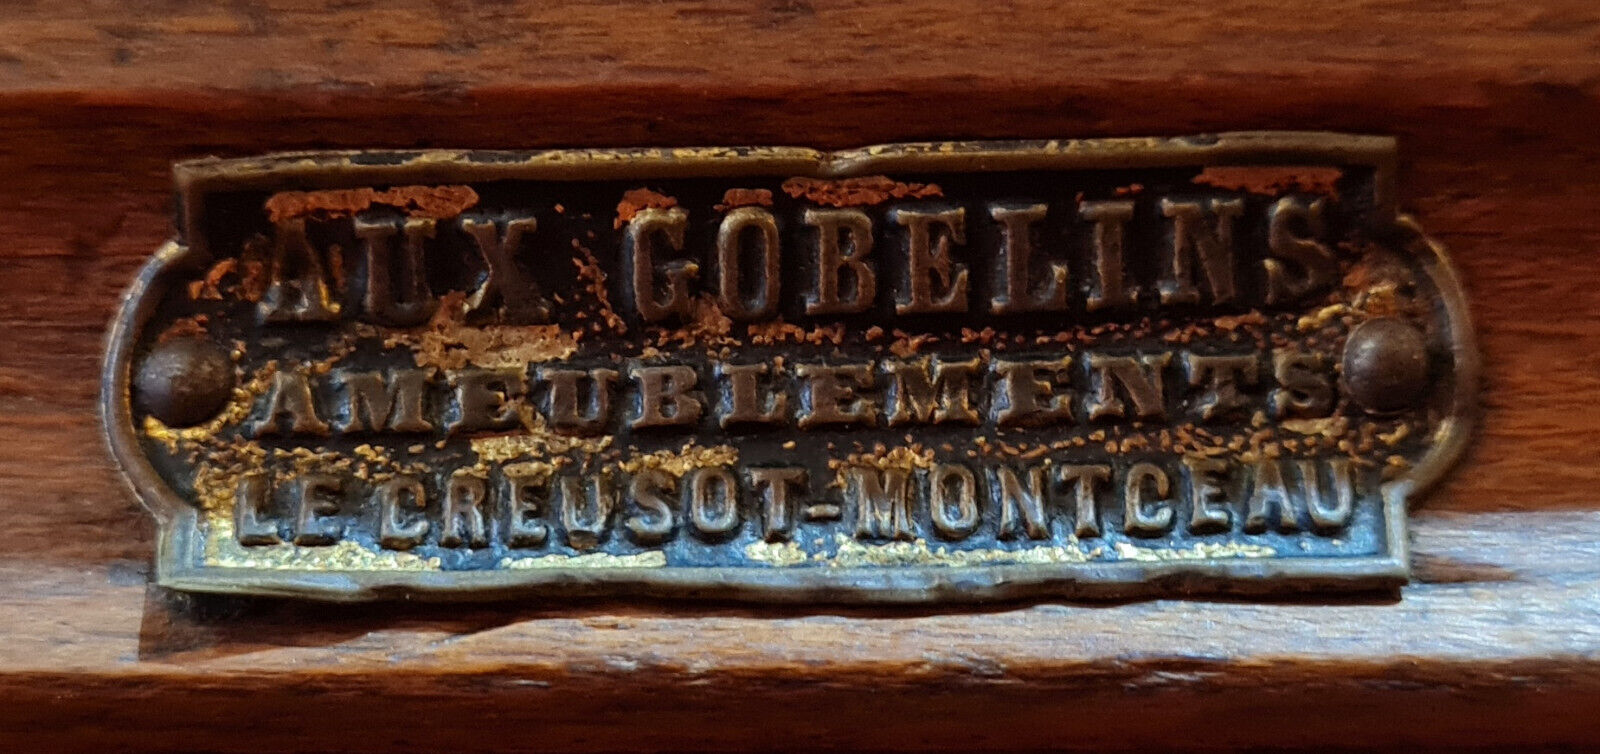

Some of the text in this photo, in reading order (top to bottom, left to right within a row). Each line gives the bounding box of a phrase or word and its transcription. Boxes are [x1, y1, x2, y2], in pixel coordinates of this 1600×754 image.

[256, 195, 1341, 326] AUX GOBELINS
[251, 350, 1339, 436] AMEUBLEMENTS
[236, 470, 344, 546] LE
